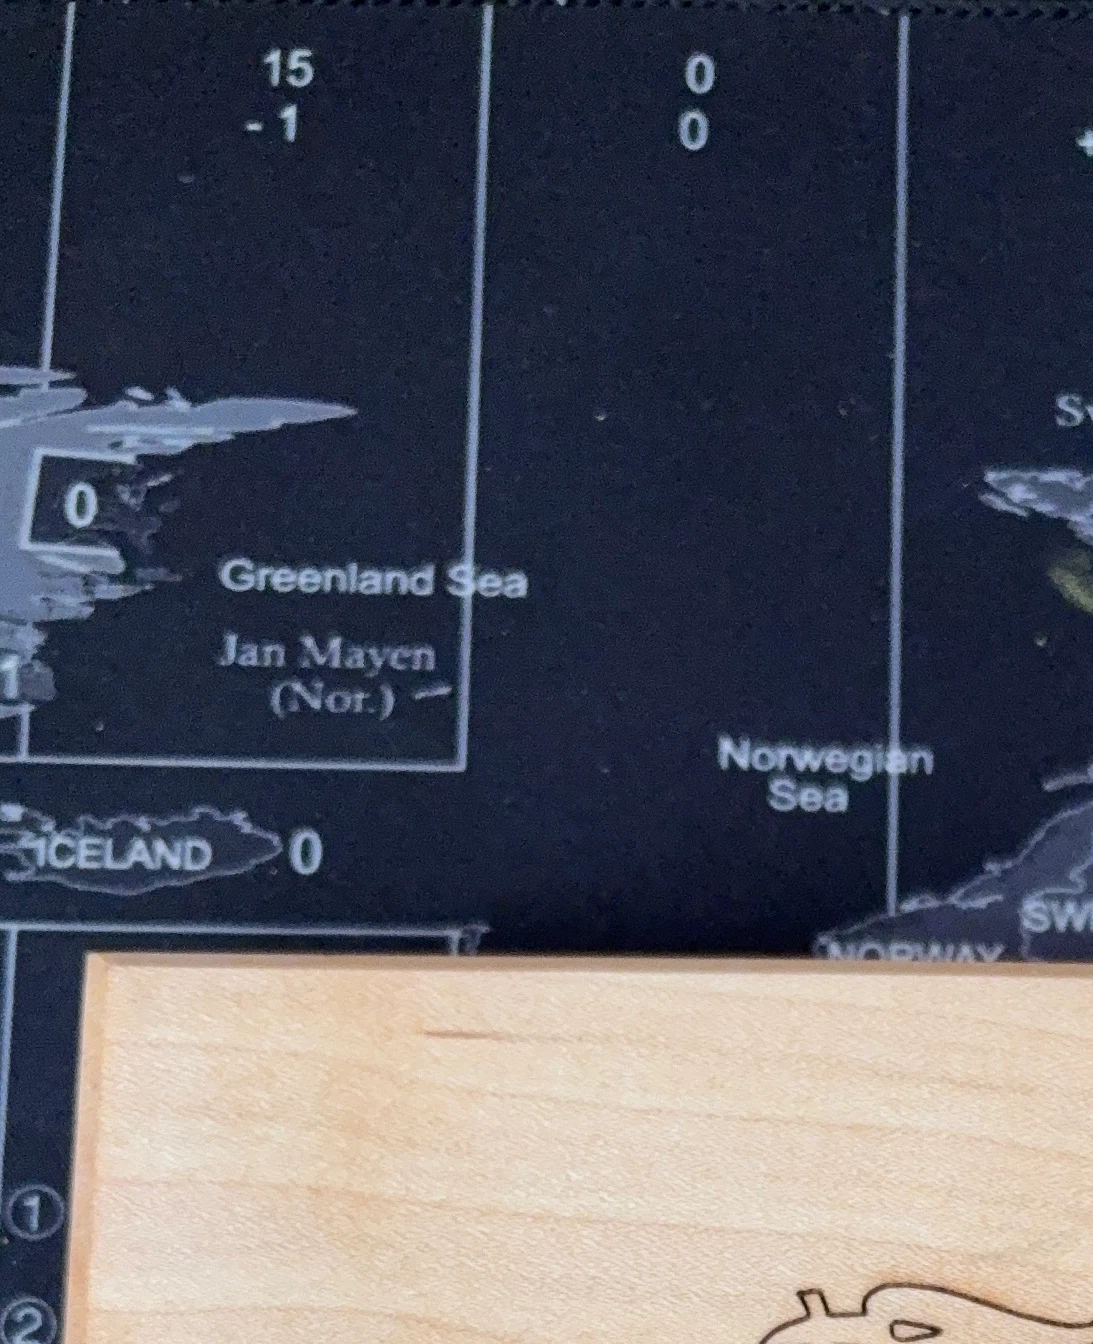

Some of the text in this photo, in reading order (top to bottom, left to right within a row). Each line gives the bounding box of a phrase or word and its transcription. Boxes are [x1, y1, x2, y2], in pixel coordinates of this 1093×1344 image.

[263, 48, 314, 88] 15
[685, 53, 716, 94] 0
[678, 110, 710, 151] 0
[65, 483, 98, 528] 0
[220, 557, 528, 599] Greenland Sea
[217, 632, 436, 676] Jan Mayen
[270, 679, 396, 718] (Nor.)
[717, 737, 934, 781] Norwegian
[767, 779, 849, 813] Sea
[36, 836, 213, 872] ICELAND
[290, 831, 323, 876] 0
